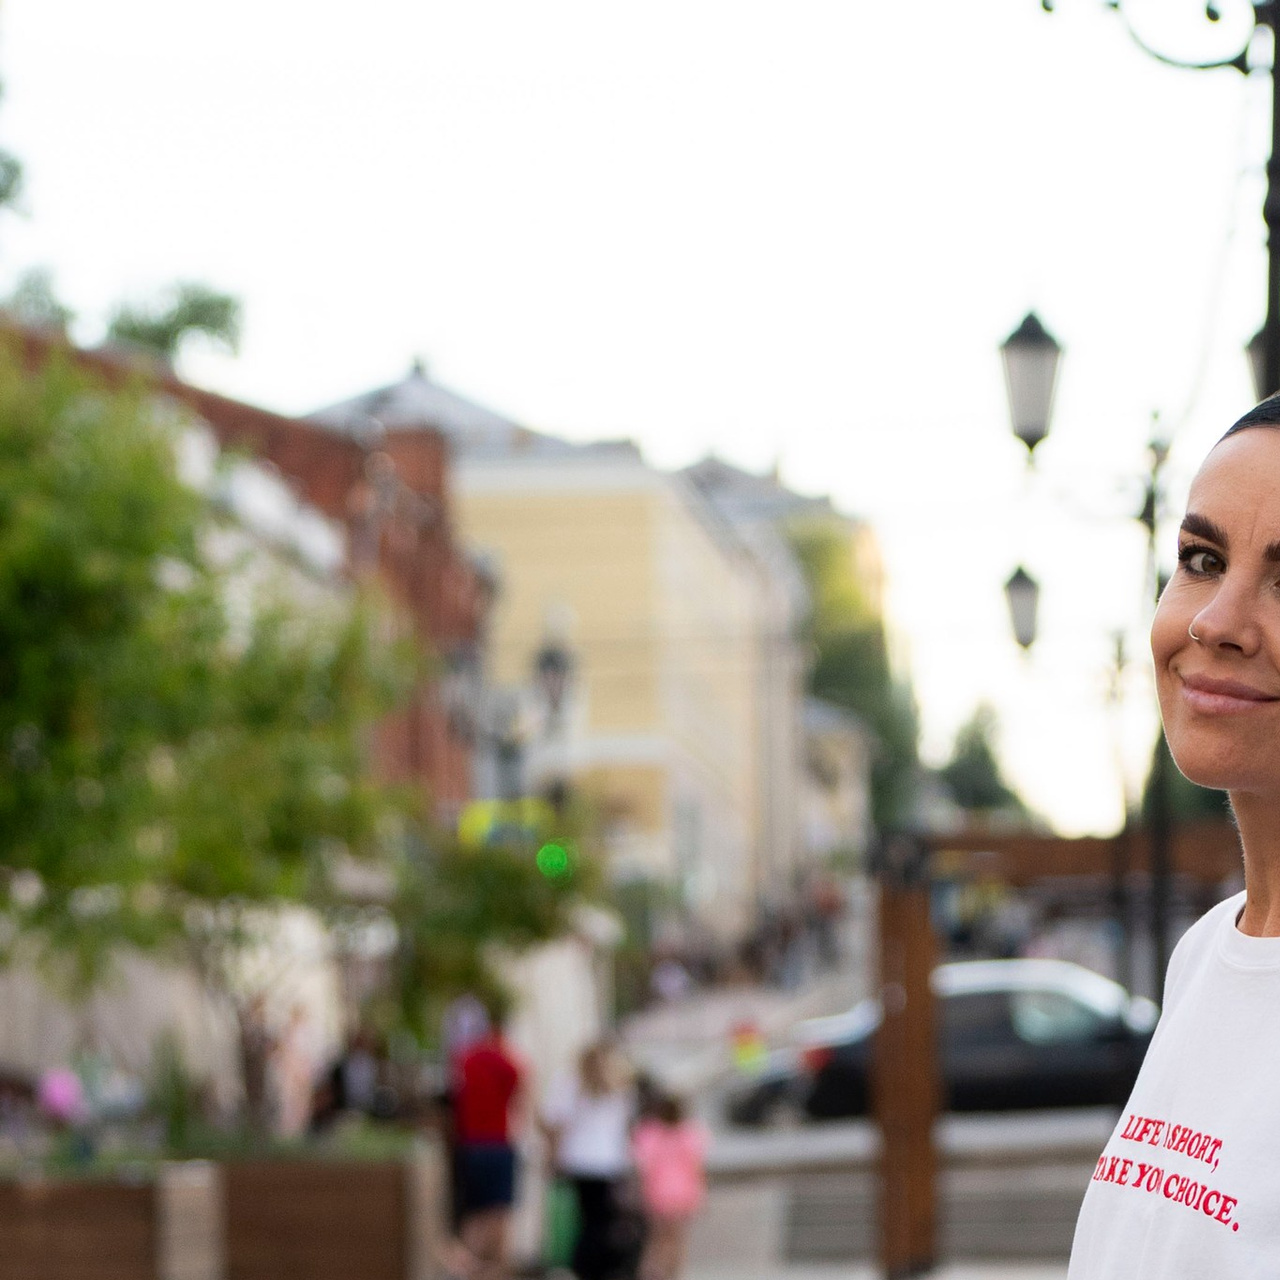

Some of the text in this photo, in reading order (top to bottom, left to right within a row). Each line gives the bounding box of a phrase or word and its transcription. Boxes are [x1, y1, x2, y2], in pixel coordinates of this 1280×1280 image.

[1120, 1114, 1166, 1147] LIFE
[1166, 1123, 1223, 1174] SHORT,
[1163, 1173, 1240, 1232] CHOICE.
